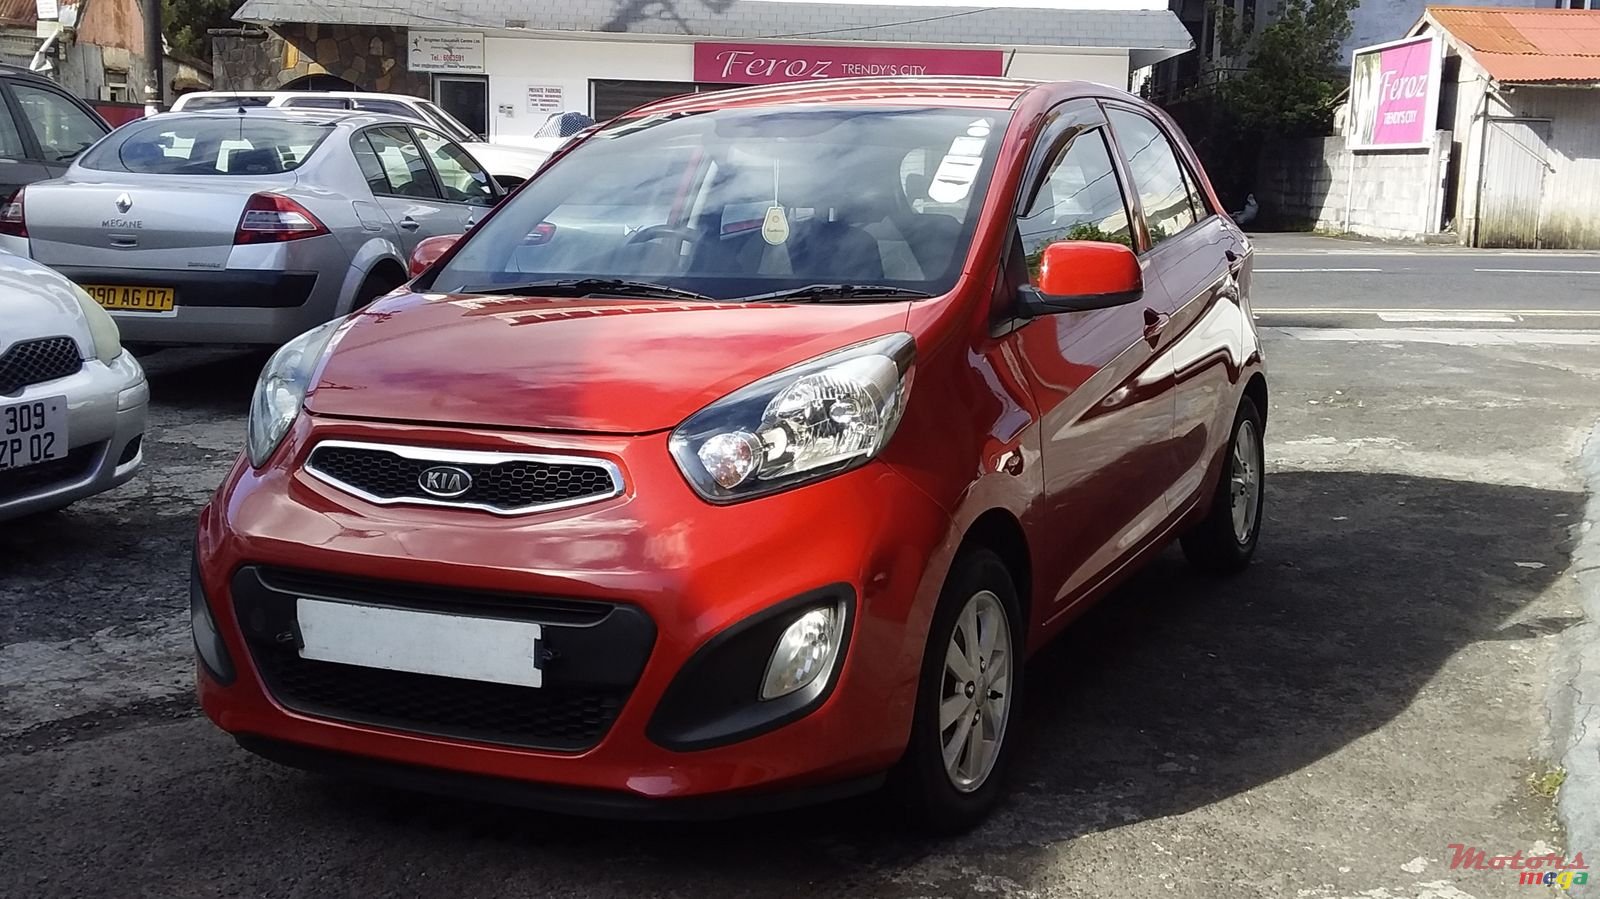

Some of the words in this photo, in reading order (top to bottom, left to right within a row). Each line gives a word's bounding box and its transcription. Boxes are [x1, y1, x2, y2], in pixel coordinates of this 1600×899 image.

[716, 50, 832, 78] Feroz
[841, 63, 897, 76] TRENDY'S
[900, 64, 927, 76] CITY
[1379, 70, 1428, 106] Feroz
[102, 218, 143, 229] MEGANE
[121, 288, 141, 306] AG
[146, 290, 166, 307] 07
[5, 402, 45, 435] 309
[30, 431, 55, 462] 02
[427, 471, 461, 490] KIA
